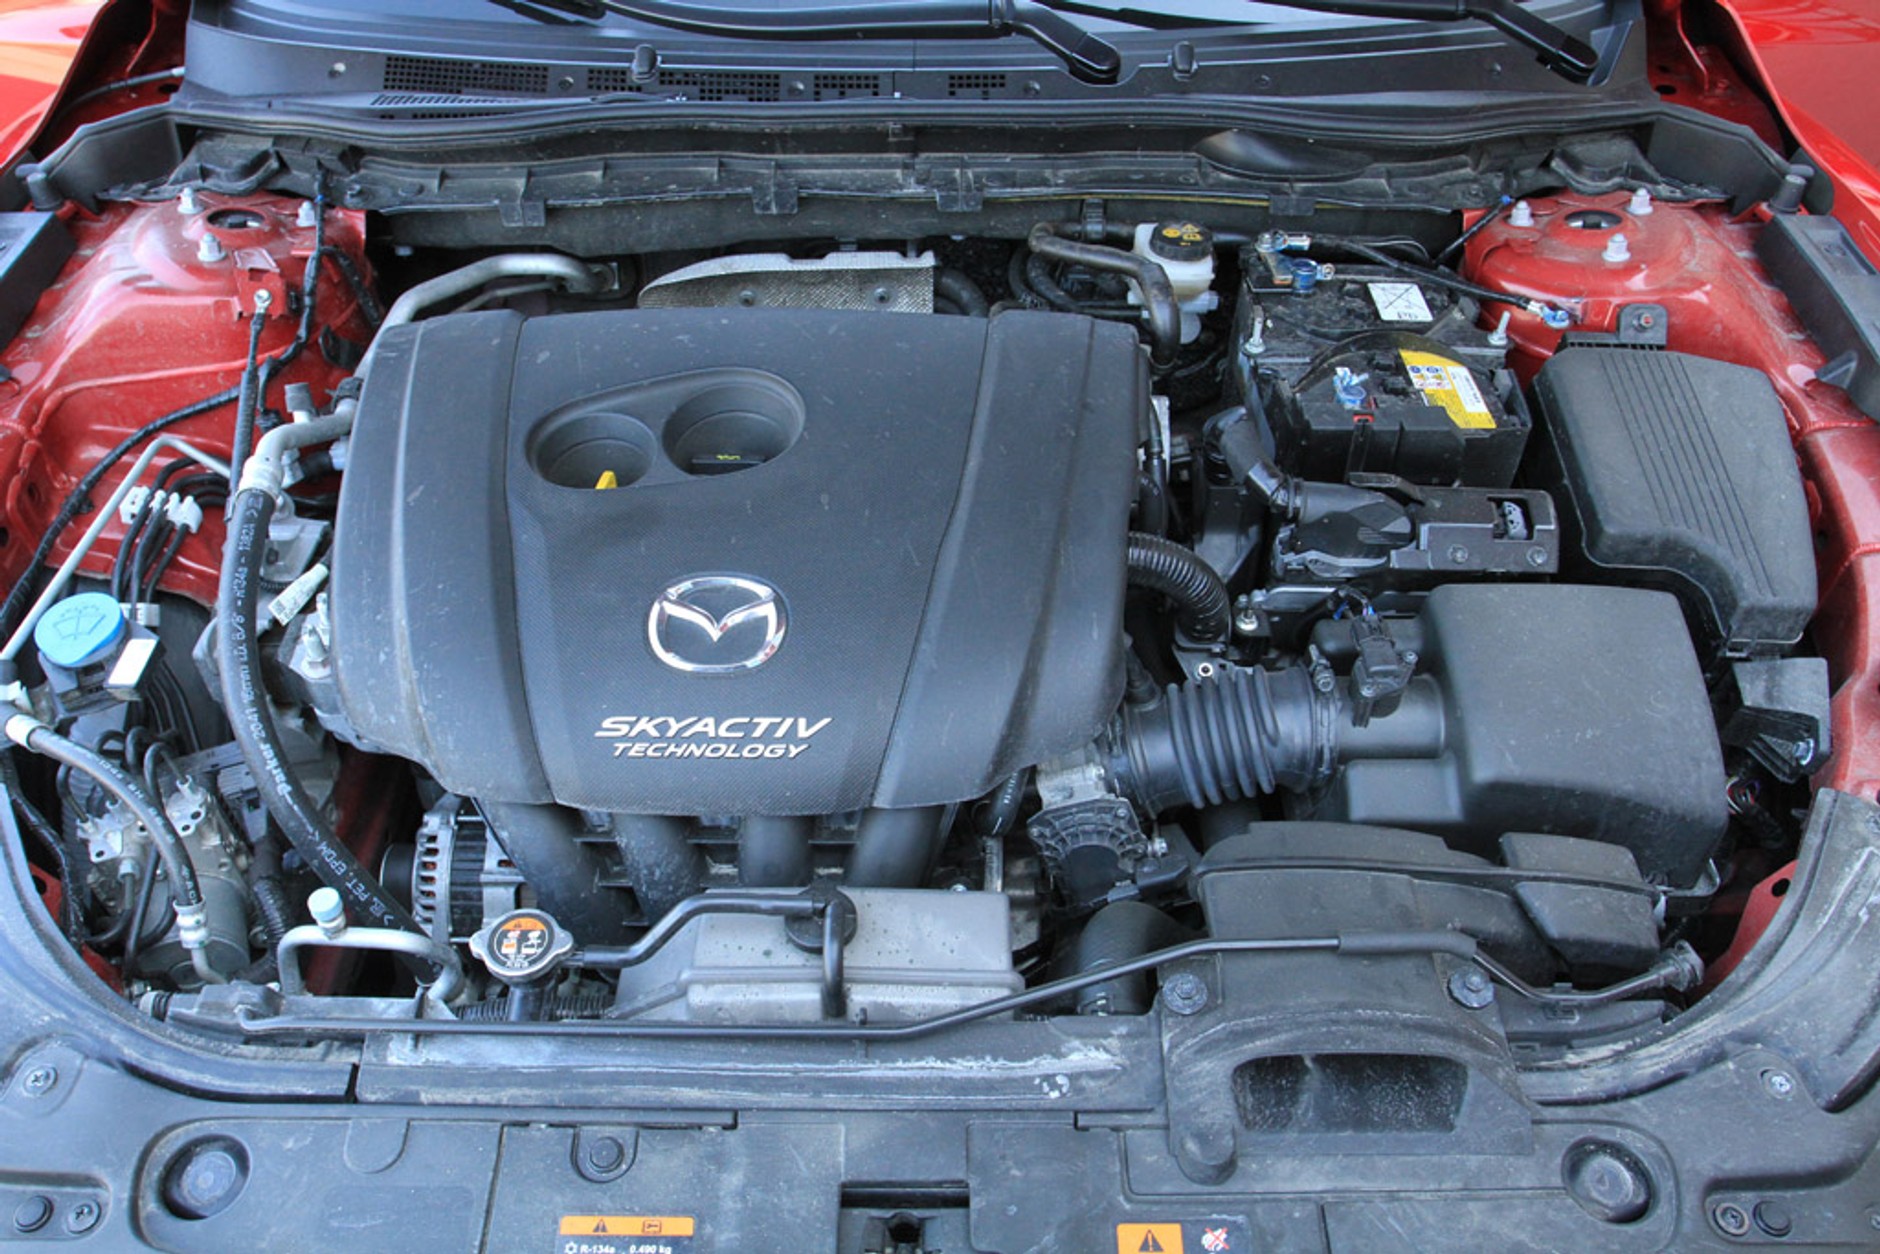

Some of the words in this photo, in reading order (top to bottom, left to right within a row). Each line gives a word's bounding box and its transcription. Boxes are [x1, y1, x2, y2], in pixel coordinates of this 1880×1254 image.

[594, 716, 833, 738] SKYACTIV
[612, 742, 809, 759] TECHNOLOGY
[259, 741, 293, 797] Parker
[658, 1243, 672, 1254] kg
